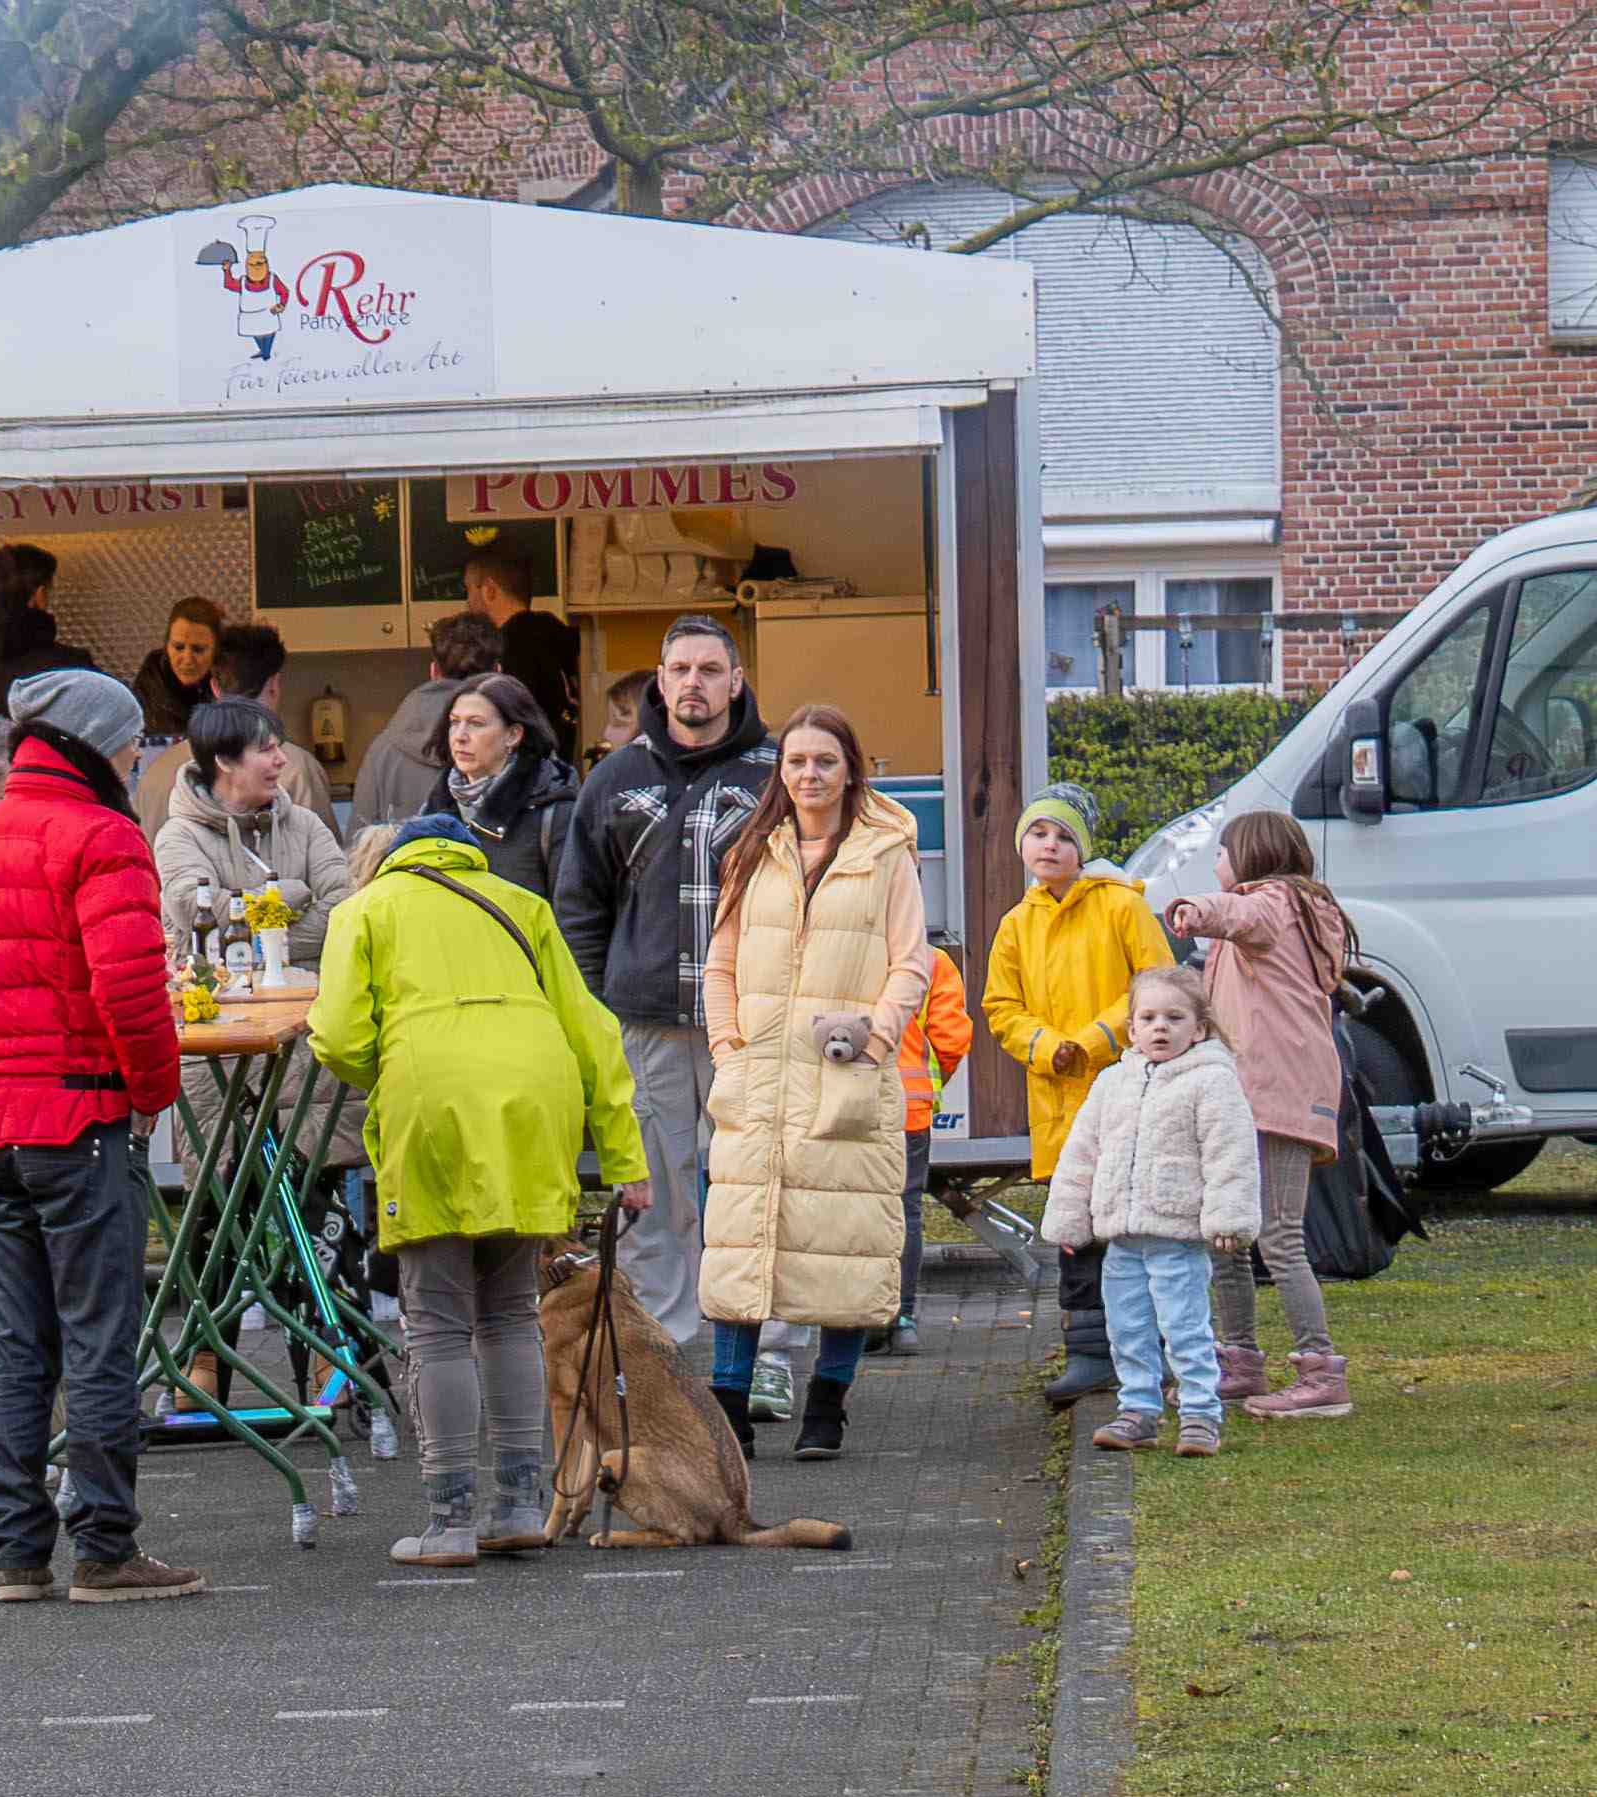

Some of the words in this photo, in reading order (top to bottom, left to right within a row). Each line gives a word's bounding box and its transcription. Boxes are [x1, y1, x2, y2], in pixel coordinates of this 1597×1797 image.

[296, 250, 416, 344] Rehr
[299, 311, 411, 332] Partyervice
[469, 463, 798, 513] POMMES
